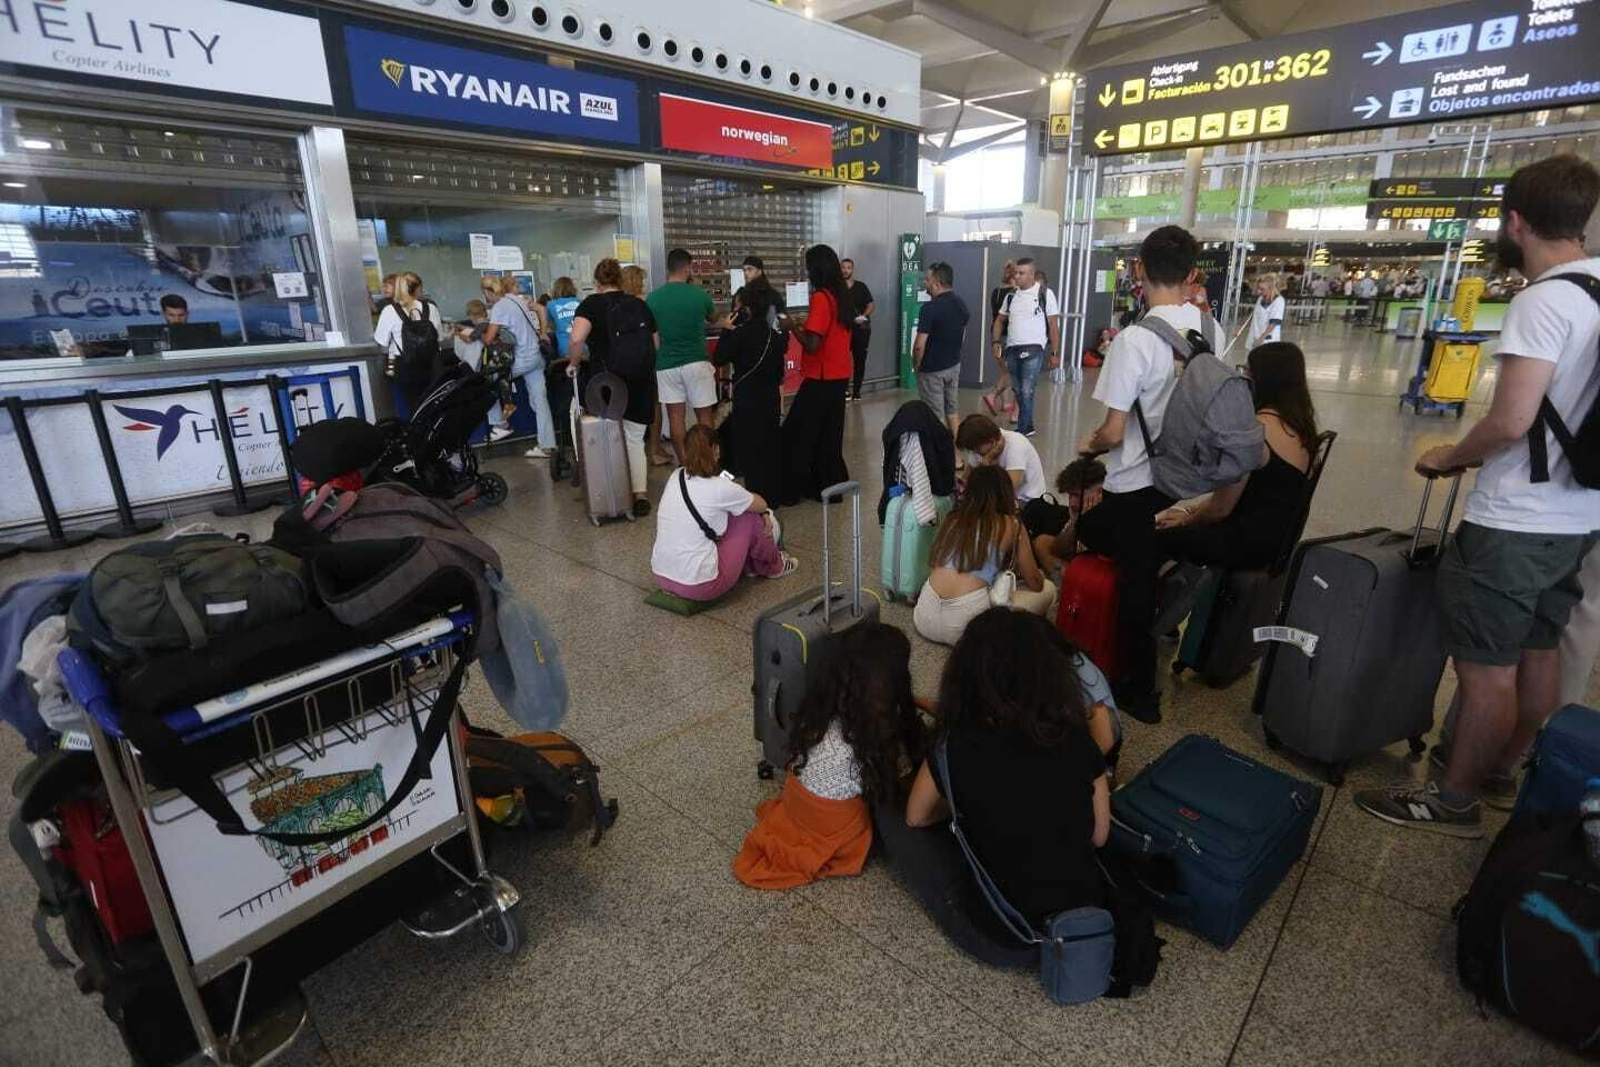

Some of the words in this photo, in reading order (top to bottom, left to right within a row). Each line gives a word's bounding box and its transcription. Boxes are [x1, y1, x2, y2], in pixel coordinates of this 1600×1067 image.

[1528, 9, 1574, 26] Toilets
[1522, 24, 1579, 43] Aseos
[52, 49, 108, 69] Copter
[114, 59, 172, 78] Airlines
[1149, 75, 1184, 88] Check-in
[1433, 65, 1507, 84] Fundsachen
[409, 64, 571, 115] RYANAIR
[1148, 81, 1211, 100] Facturación
[1430, 84, 1459, 98] Lost
[1462, 80, 1488, 94] and
[1491, 73, 1530, 90] found
[586, 98, 613, 111] AZUL
[1429, 96, 1488, 113] Objetos
[1491, 80, 1600, 105] encontrados
[721, 125, 788, 146] norwegian
[902, 263, 919, 271] DEA
[53, 289, 160, 318] Ceut
